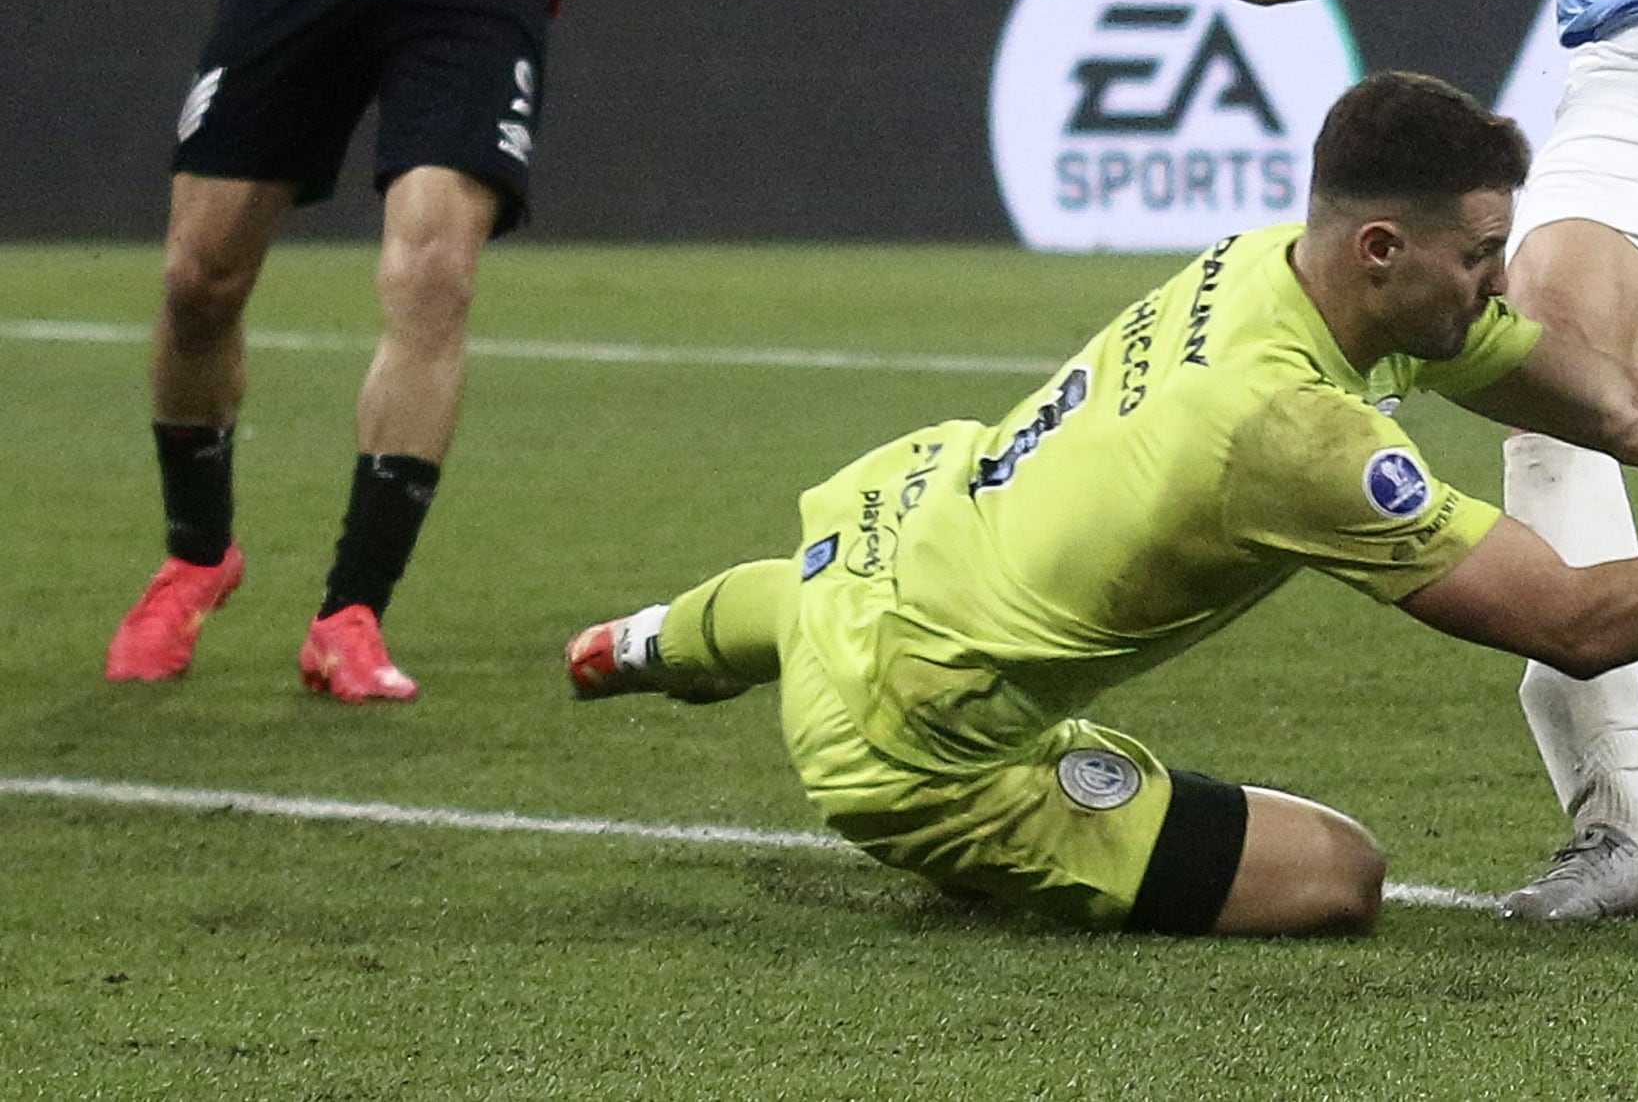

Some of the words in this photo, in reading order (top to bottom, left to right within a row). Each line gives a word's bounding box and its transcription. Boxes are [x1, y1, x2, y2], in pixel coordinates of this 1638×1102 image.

[1062, 2, 1287, 136] EA
[1056, 151, 1297, 210] SPORTS
[1118, 290, 1158, 416] HICCO
[968, 368, 1088, 499] 1
